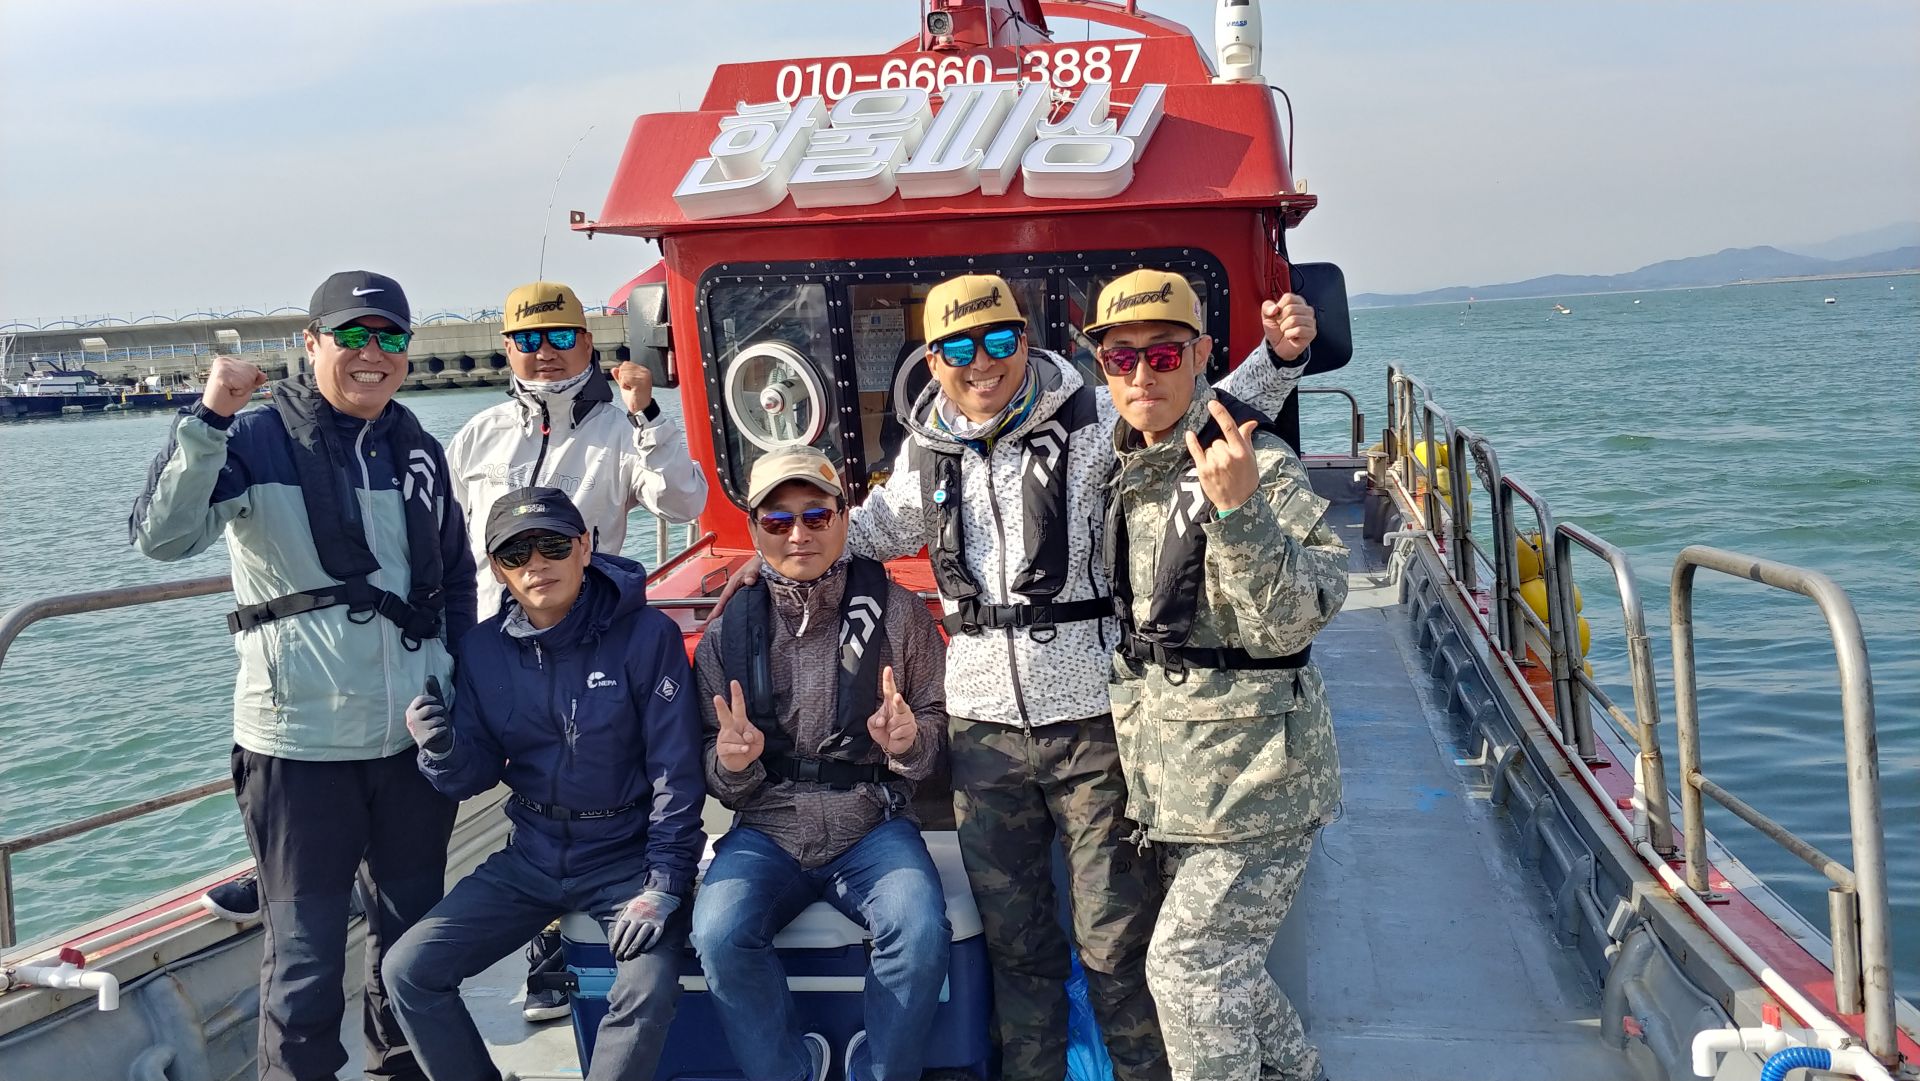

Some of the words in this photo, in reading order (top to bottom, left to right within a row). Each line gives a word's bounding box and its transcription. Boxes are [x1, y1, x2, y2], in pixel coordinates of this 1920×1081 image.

[776, 43, 1142, 103] 010-6660-3887
[672, 81, 1167, 220] 한울피싱
[598, 679, 618, 687] NEPA
